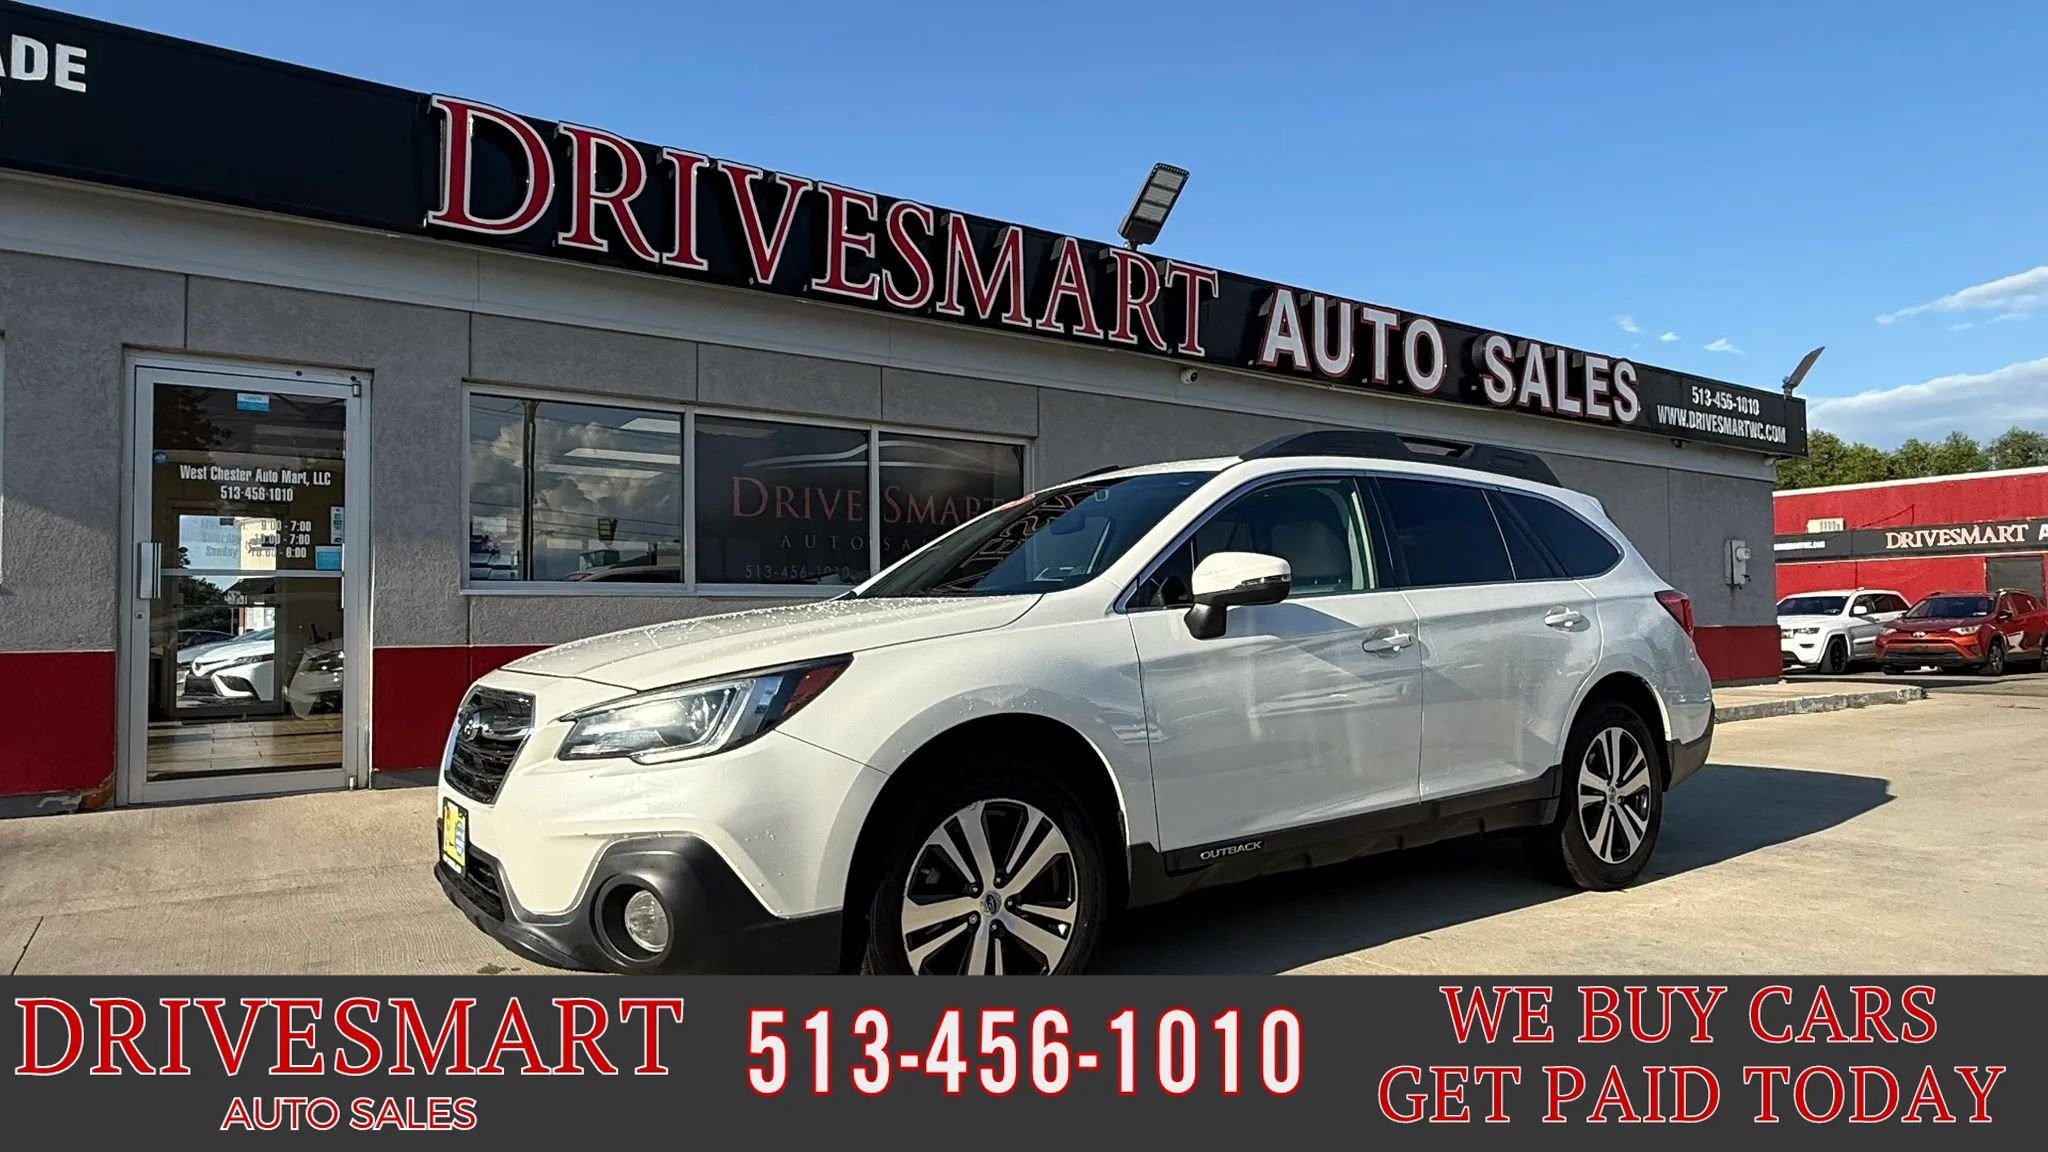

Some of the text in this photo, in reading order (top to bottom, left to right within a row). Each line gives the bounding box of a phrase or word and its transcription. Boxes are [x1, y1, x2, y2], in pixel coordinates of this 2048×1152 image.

[426, 93, 1641, 425] DRIVESMART AUTO SALES
[1691, 385, 1760, 416] 513-456-1010
[1656, 404, 1787, 444] WWW.DRIVESMARTWC.COM
[179, 464, 331, 487] West Chester Auto Mart, LLC
[220, 485, 294, 502] 513-456-1010
[290, 520, 312, 532] 7:00
[1885, 523, 2029, 550] DRIVESMART
[289, 533, 311, 545] 7:00
[780, 535, 865, 551] AUTO
[1200, 840, 1263, 860] OUTBACK
